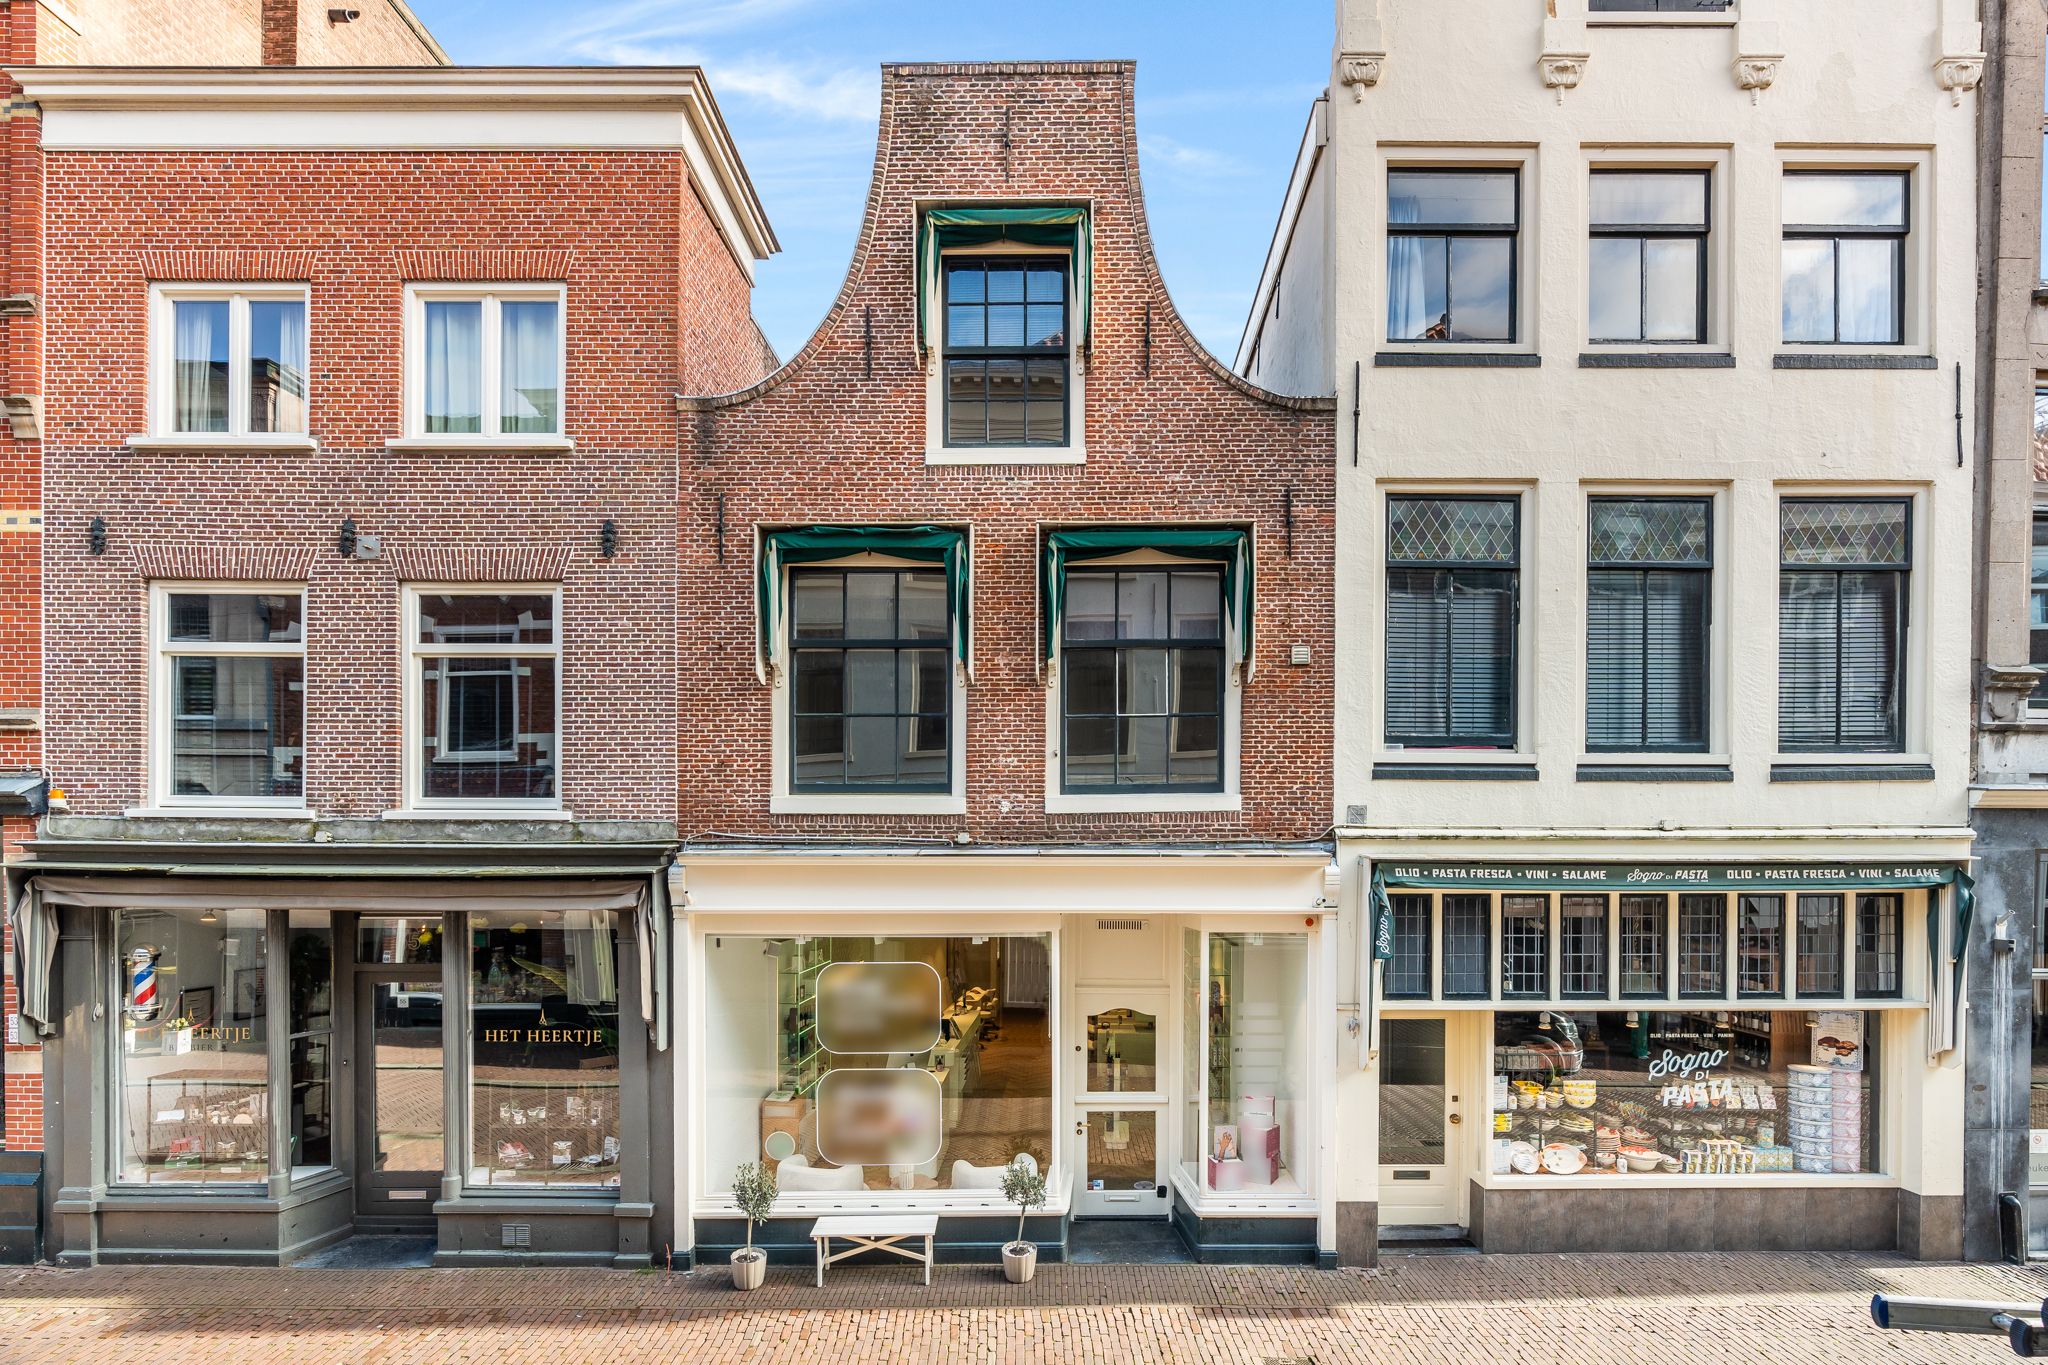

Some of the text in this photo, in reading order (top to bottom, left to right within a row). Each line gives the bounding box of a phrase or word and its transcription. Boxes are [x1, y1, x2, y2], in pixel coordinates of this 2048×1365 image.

[1395, 868, 1607, 880] OLIO PASTA FRESCA VINI SALAME
[1627, 868, 1665, 883] Sogno
[1674, 869, 1709, 880] PASTA
[1726, 868, 1941, 879] OLIO PASTA FRESCA VINI SALAME
[1376, 915, 1391, 954] Sogno
[485, 1029, 602, 1047] HET HEERTJE
[1648, 1049, 1729, 1080] Sogno
[1695, 1070, 1710, 1080] DI
[1663, 1080, 1733, 1107] PASTA
